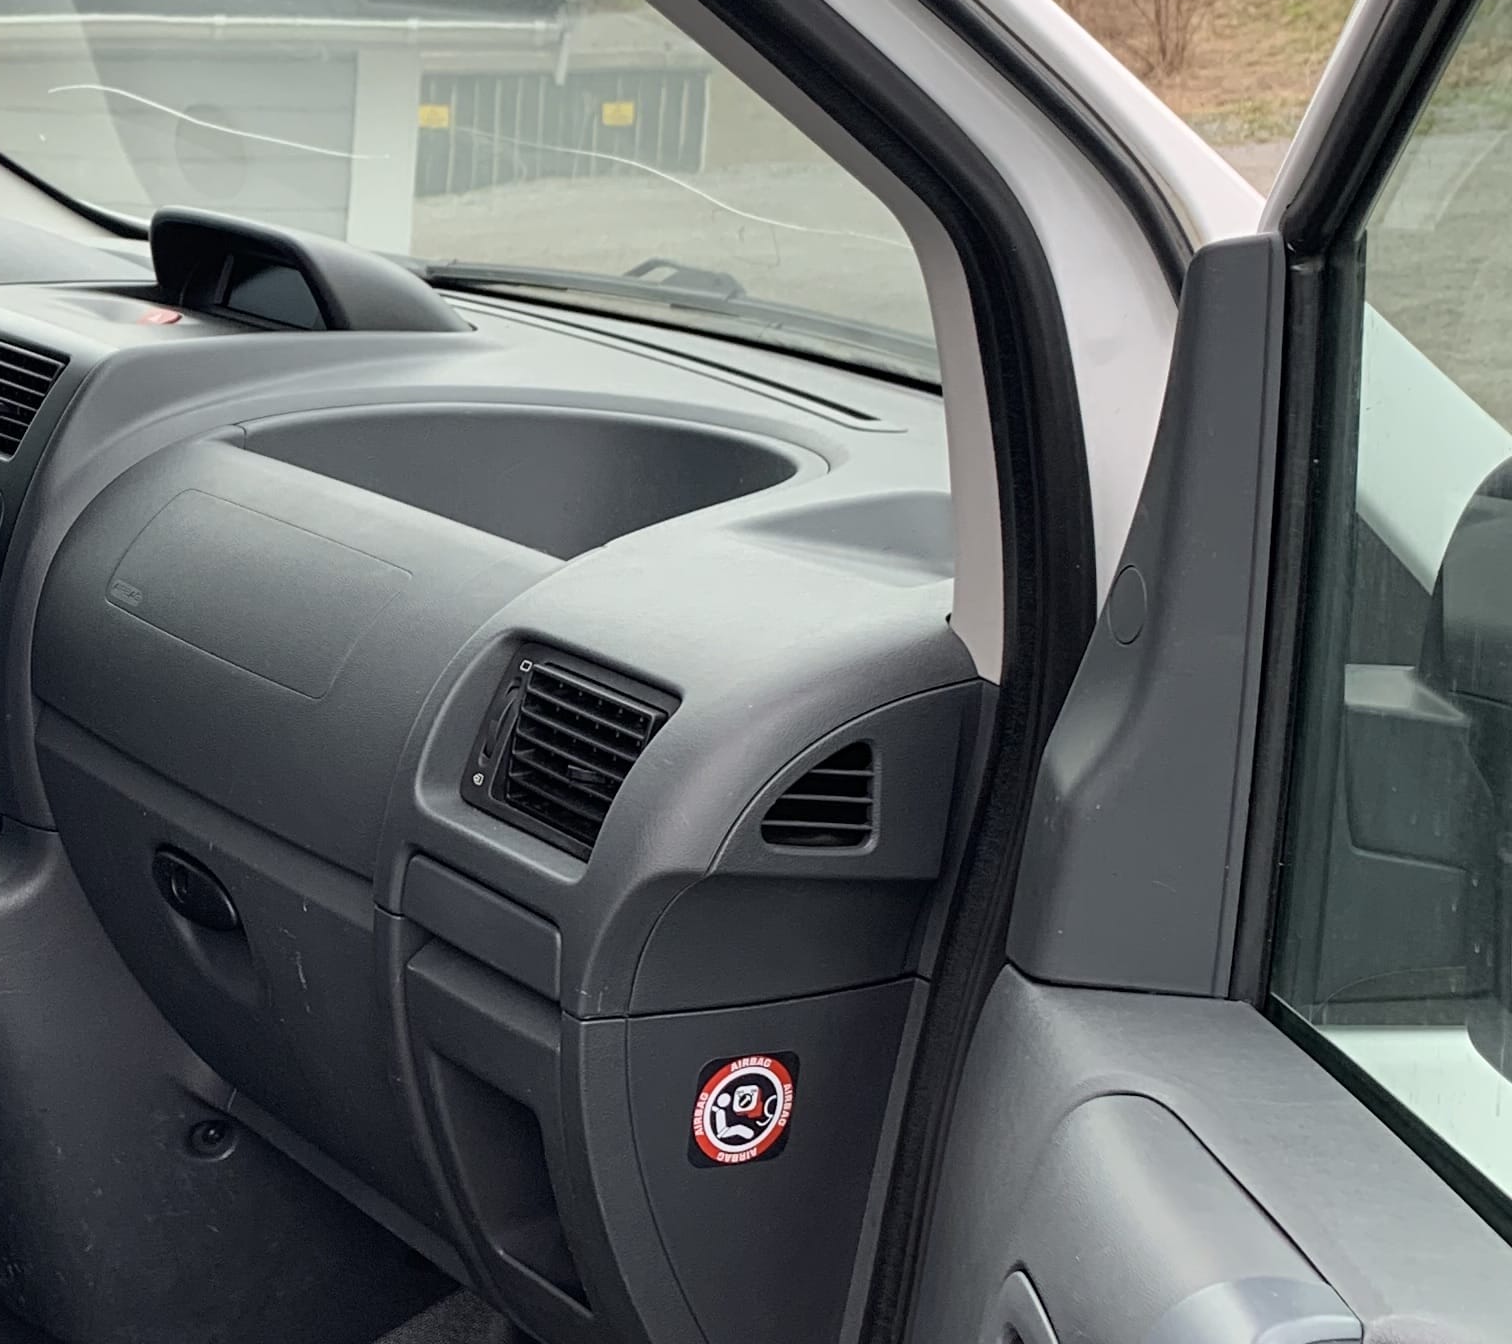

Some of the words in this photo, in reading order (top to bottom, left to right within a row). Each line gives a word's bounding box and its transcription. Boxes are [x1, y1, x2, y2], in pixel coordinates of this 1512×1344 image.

[730, 1057, 772, 1072] AIRBAG
[694, 1092, 709, 1136] AIRBAG
[778, 1083, 793, 1127] AIRBAG
[716, 1147, 758, 1163] AIRBAG
